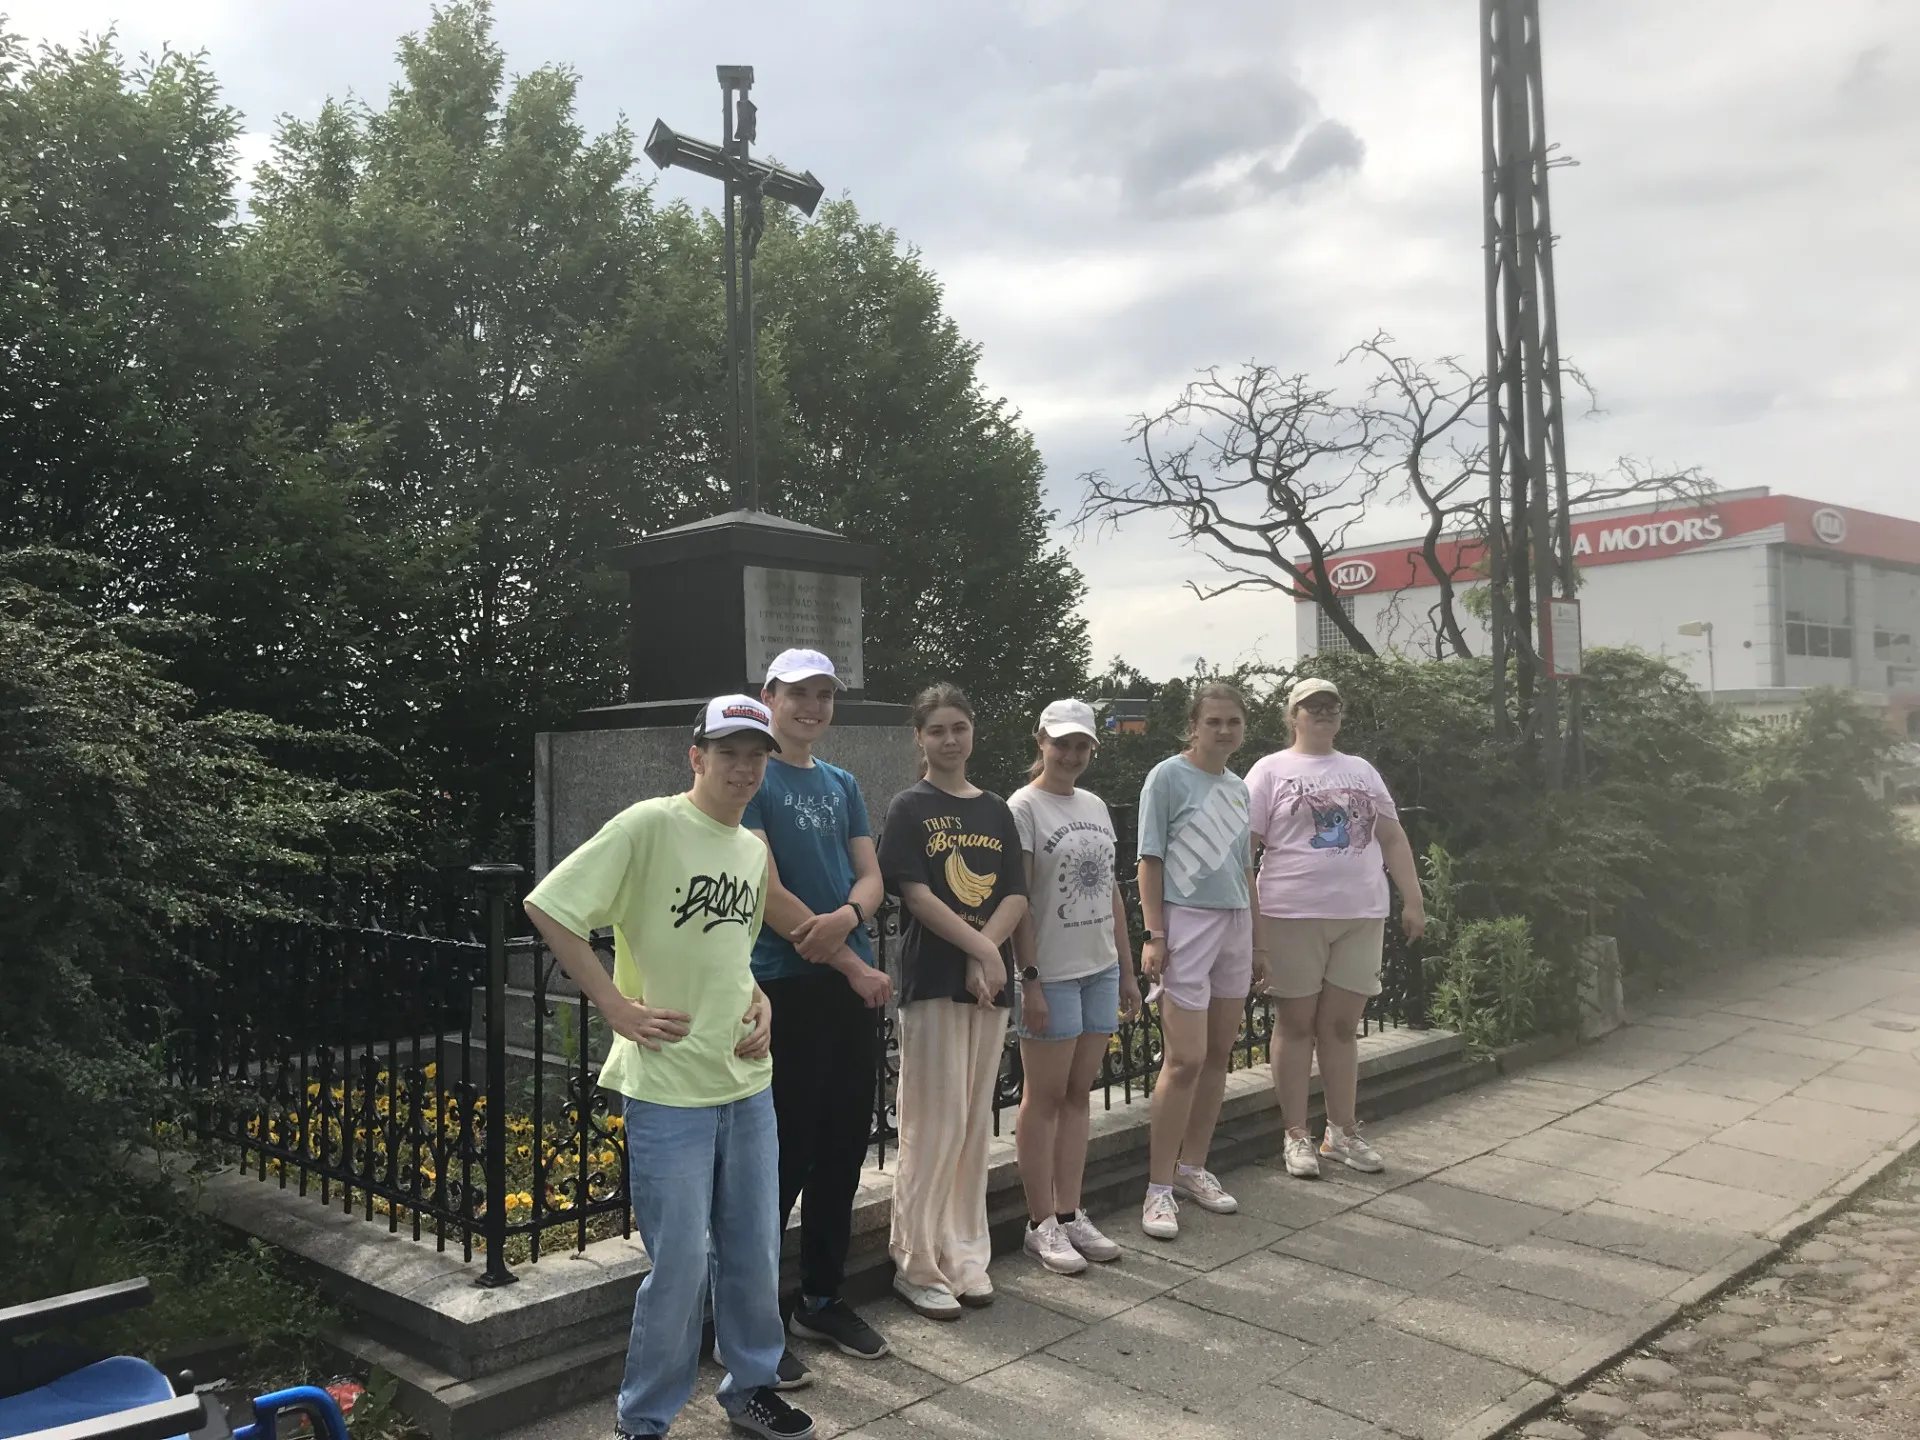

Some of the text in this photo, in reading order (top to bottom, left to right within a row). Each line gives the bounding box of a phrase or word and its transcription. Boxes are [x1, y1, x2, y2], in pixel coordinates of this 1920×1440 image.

[1598, 514, 1723, 553] MOTORS
[1337, 566, 1369, 584] KIA
[922, 815, 962, 832] THAT'S
[1043, 821, 1113, 854] MIND ILLUSIO
